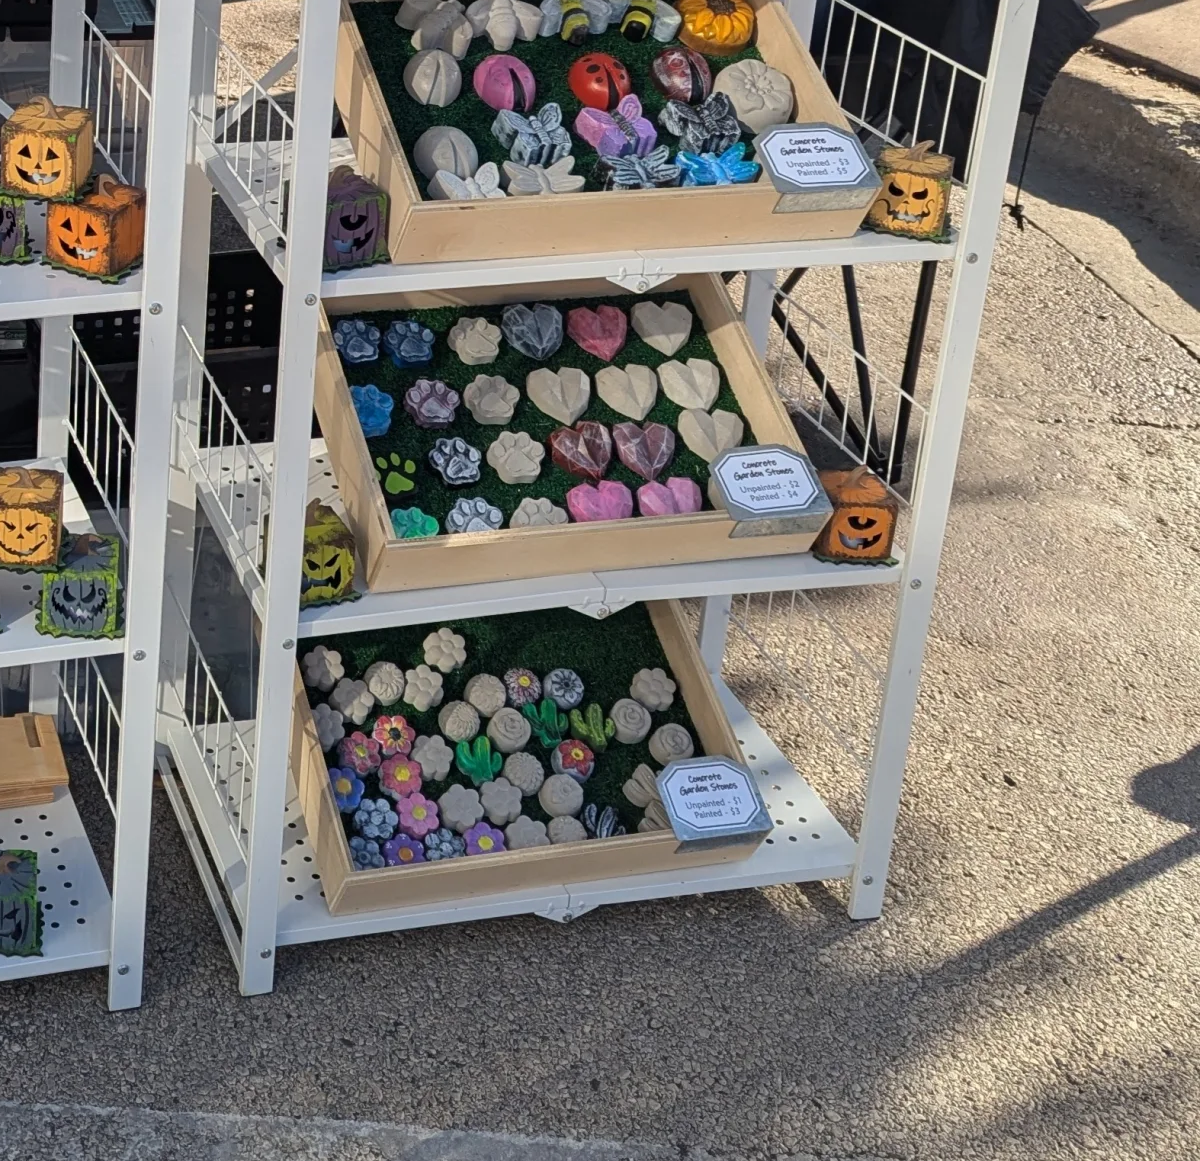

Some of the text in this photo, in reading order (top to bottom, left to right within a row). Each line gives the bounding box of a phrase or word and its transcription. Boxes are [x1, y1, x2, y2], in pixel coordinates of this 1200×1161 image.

[788, 138, 826, 146] Concrete
[780, 145, 844, 156] Garden Stones
[786, 159, 831, 169] Unpainted
[838, 158, 850, 167] $3
[796, 168, 828, 177] Painted
[837, 167, 848, 175] $5
[742, 459, 777, 469] Concrete
[733, 467, 794, 481] Garden Stones
[739, 482, 781, 494] Unpainted
[789, 480, 800, 489] $2
[749, 493, 780, 502] Painted
[787, 490, 798, 499] $4
[688, 773, 722, 783] Concrete
[679, 782, 738, 796] Garden Stones
[685, 798, 725, 810] Unpainted
[734, 796, 742, 805] $1
[694, 809, 723, 819] Painted
[731, 807, 741, 816] $3
